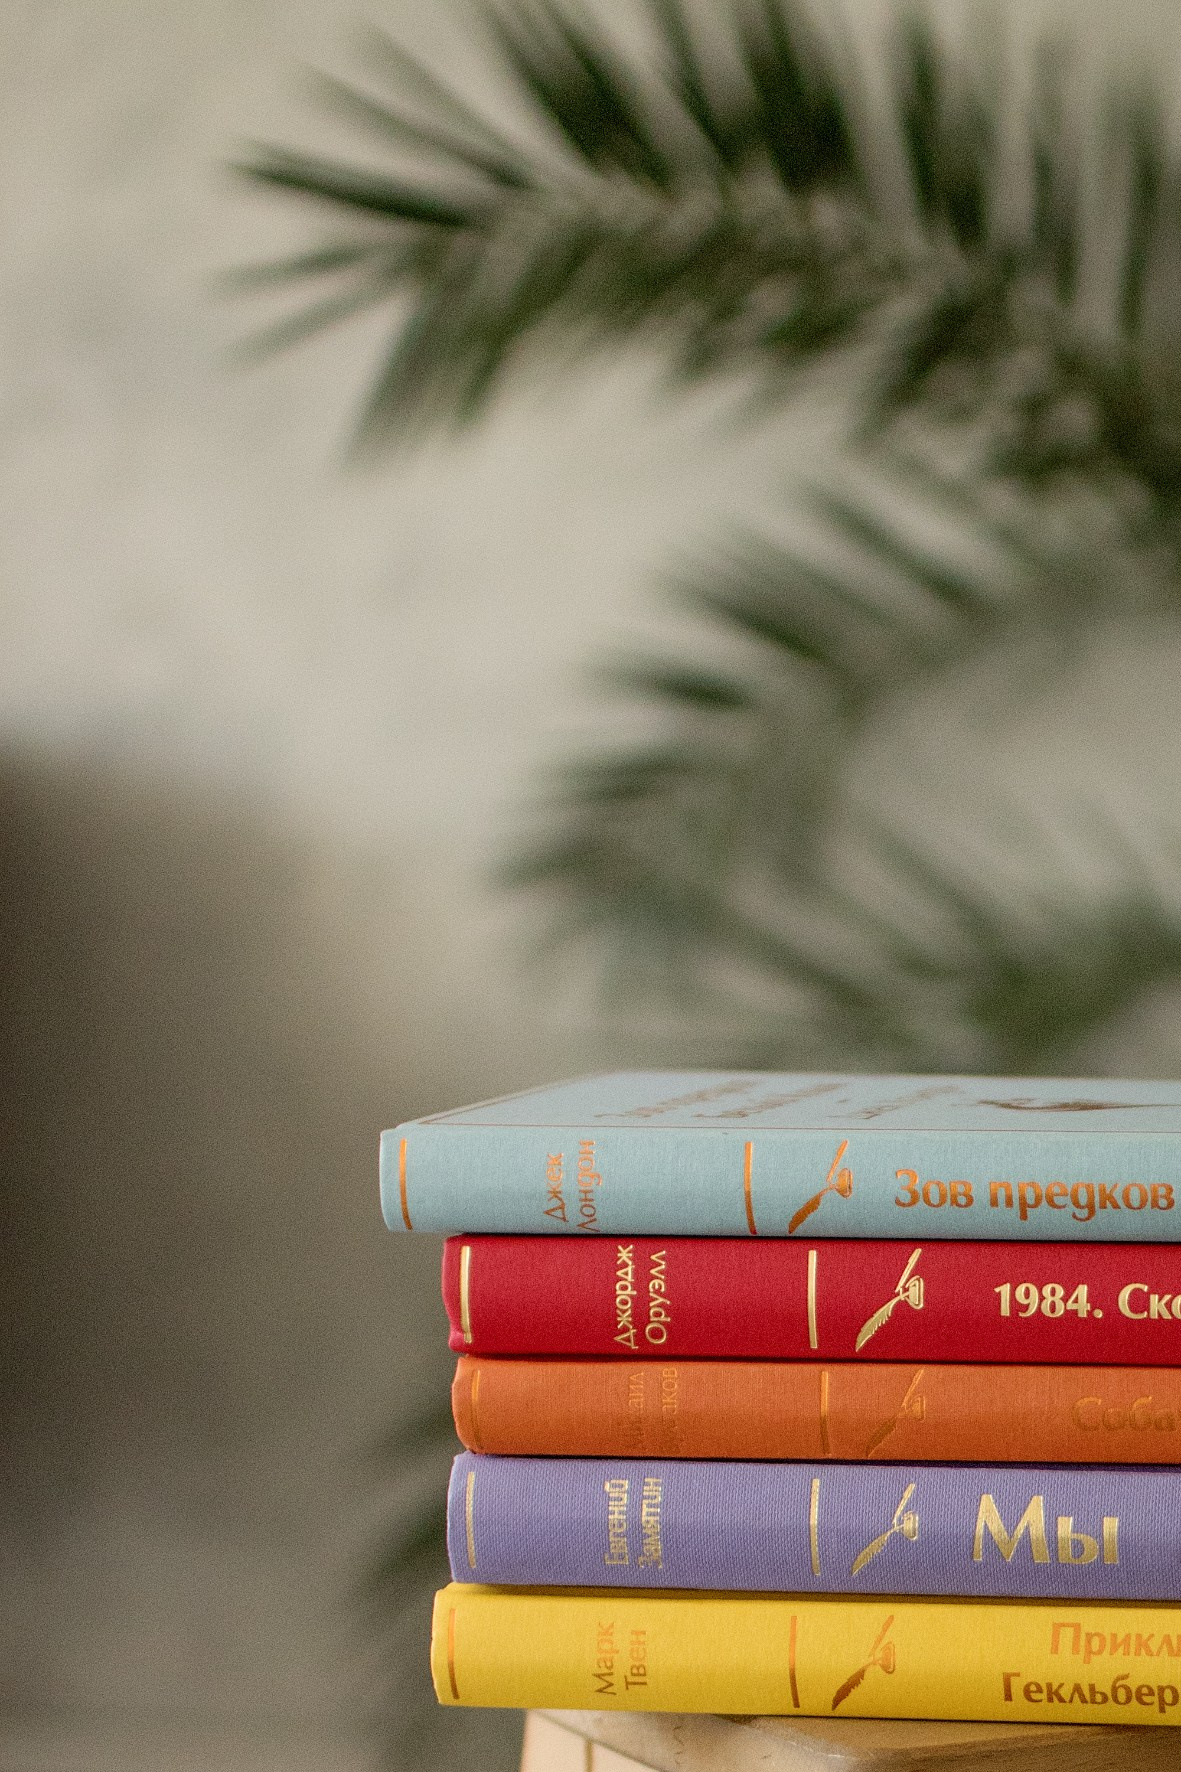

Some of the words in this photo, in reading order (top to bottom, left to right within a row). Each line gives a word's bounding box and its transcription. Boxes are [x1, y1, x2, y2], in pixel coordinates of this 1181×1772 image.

[544, 1152, 568, 1222] Джек
[576, 1140, 602, 1233] Лондон
[895, 1168, 974, 1209] Зов
[988, 1178, 1175, 1222] предков
[613, 1245, 639, 1349] Джордж
[645, 1251, 671, 1345] Оруэлл
[994, 1283, 1103, 1318] 1984.
[604, 1479, 629, 1566] Евгений
[638, 1478, 663, 1568] Замятин
[972, 1494, 1119, 1565] Мы
[592, 1621, 620, 1696] Марк
[625, 1629, 647, 1690] Твен
